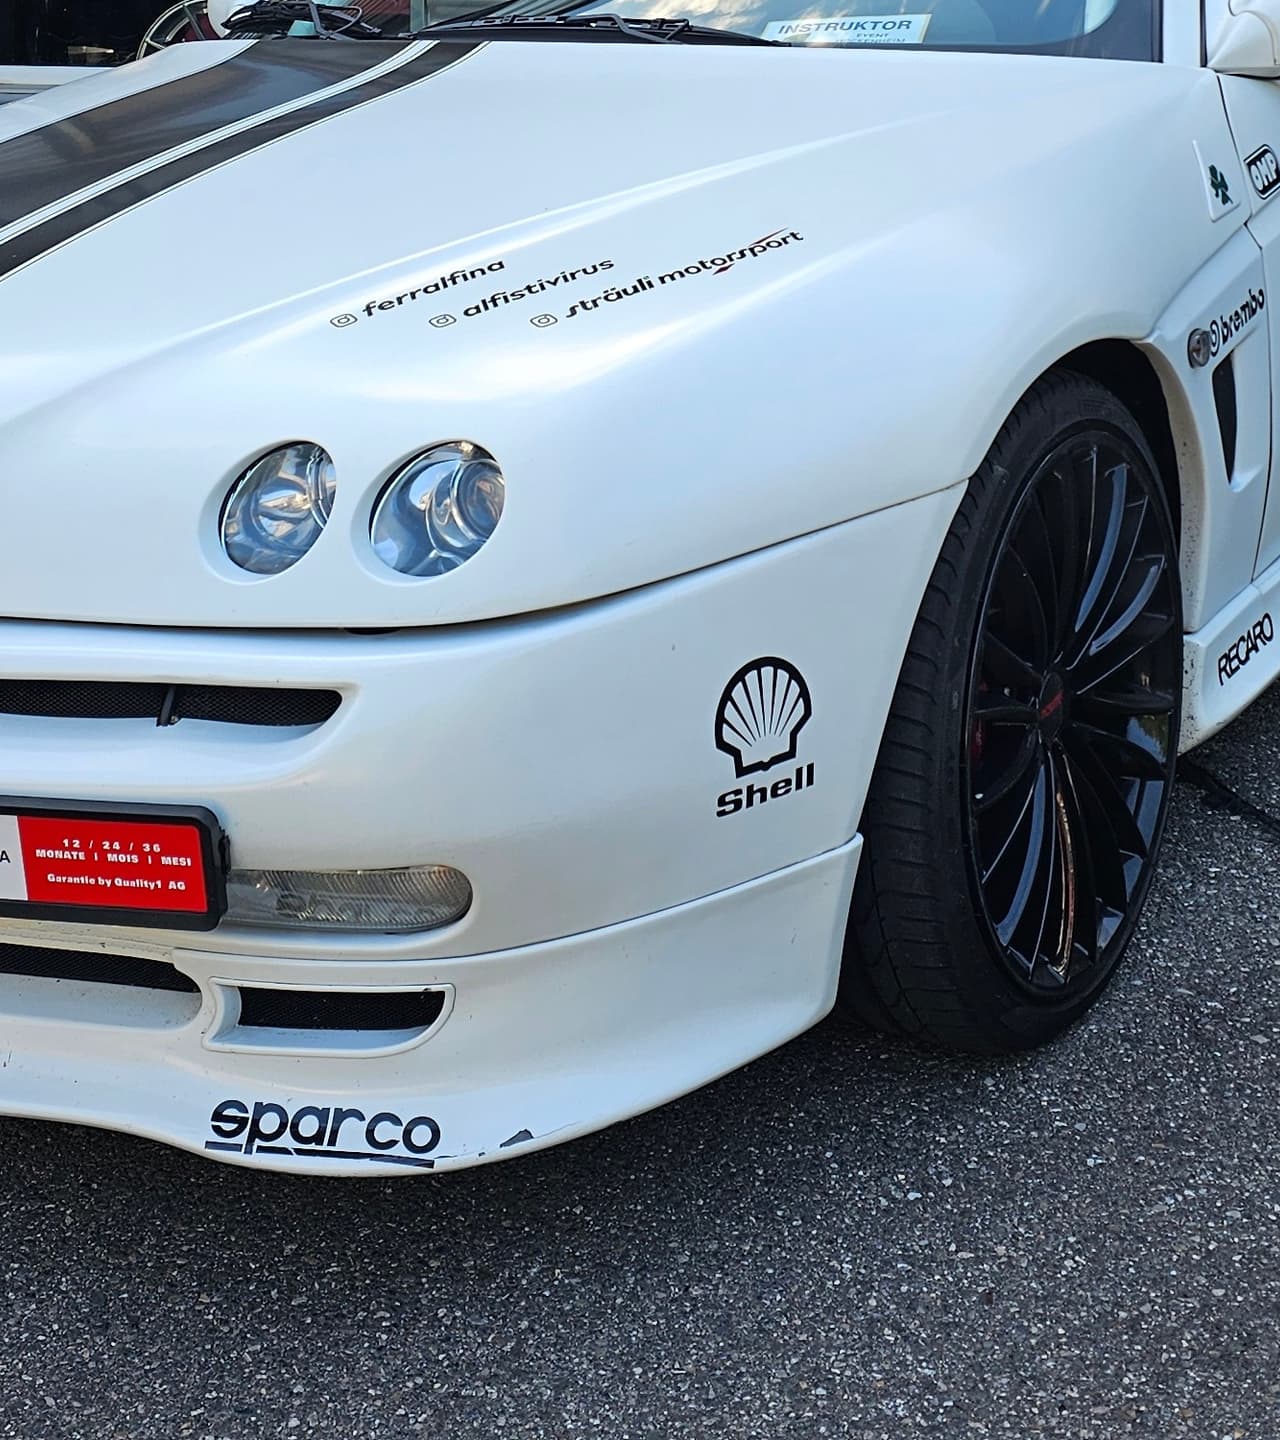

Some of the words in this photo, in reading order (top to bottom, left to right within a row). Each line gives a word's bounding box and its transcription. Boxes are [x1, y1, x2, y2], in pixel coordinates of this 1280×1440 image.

[778, 20, 913, 34] INSTRUKTOR
[1249, 151, 1278, 192] OMP
[362, 260, 506, 317] ferralfina
[463, 259, 615, 317] alfistivirus
[565, 275, 655, 319] sträuli
[658, 230, 804, 286] motorsport
[1220, 288, 1265, 345] brembo
[1218, 612, 1274, 686] RECARO
[716, 762, 815, 818] Shell
[35, 848, 86, 861] MONATE
[107, 853, 139, 864] MOIS
[161, 856, 192, 867] MESI
[62, 838, 81, 849] 12
[101, 840, 121, 850] 24
[47, 873, 96, 886] Garantie
[98, 876, 112, 888] by
[114, 877, 162, 891] Quality1
[168, 880, 186, 891] AG
[210, 1099, 441, 1155] sparco
